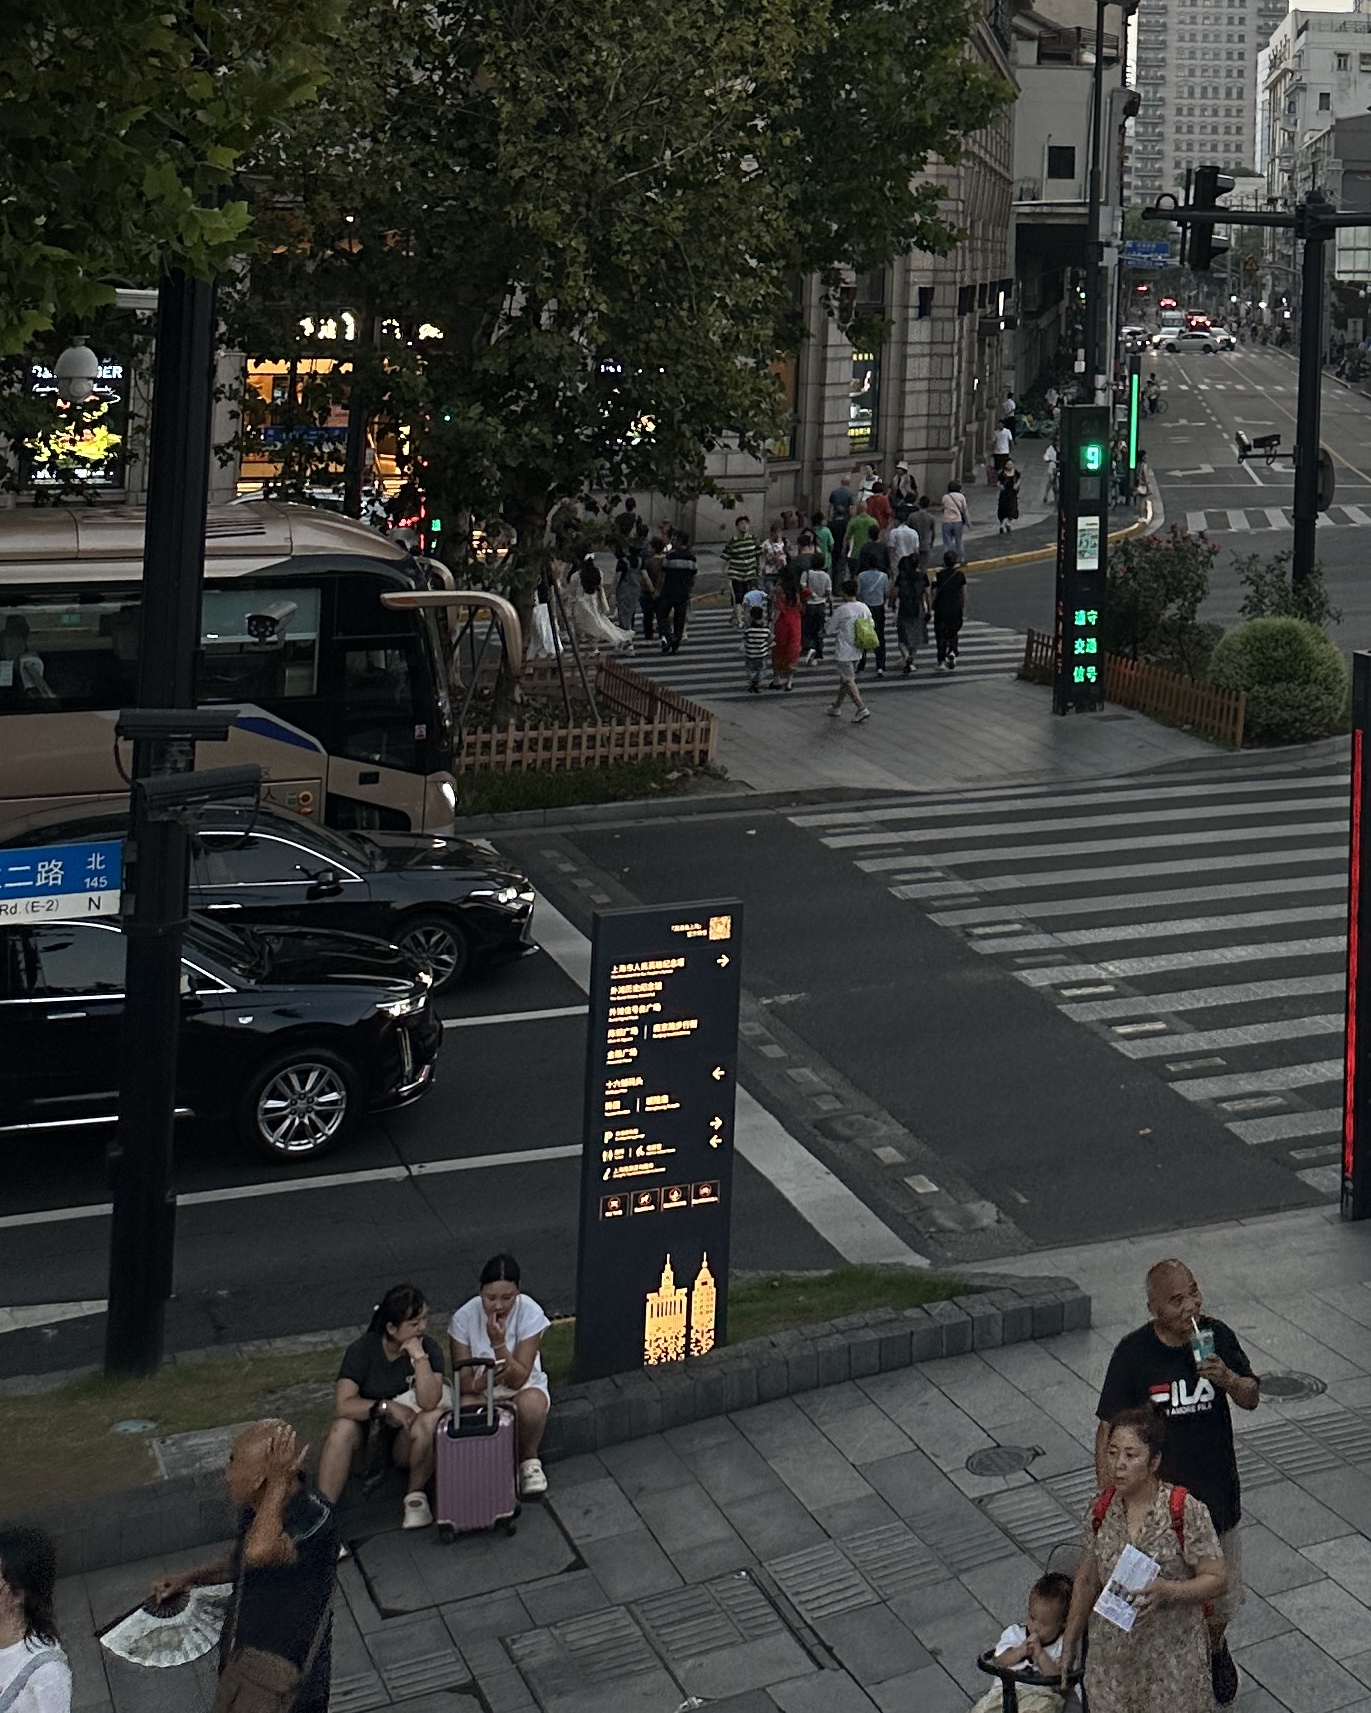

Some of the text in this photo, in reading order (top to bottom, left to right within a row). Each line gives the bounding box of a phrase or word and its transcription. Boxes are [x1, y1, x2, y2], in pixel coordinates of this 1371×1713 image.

[1086, 446, 1100, 470] 9
[1074, 638, 1097, 654] 交通
[1073, 666, 1098, 683] 信号
[0, 852, 106, 888] 二路 北
[84, 876, 108, 889] 145
[25, 898, 59, 915] (E-2)
[88, 895, 101, 911] N
[1148, 1376, 1215, 1407] FILA
